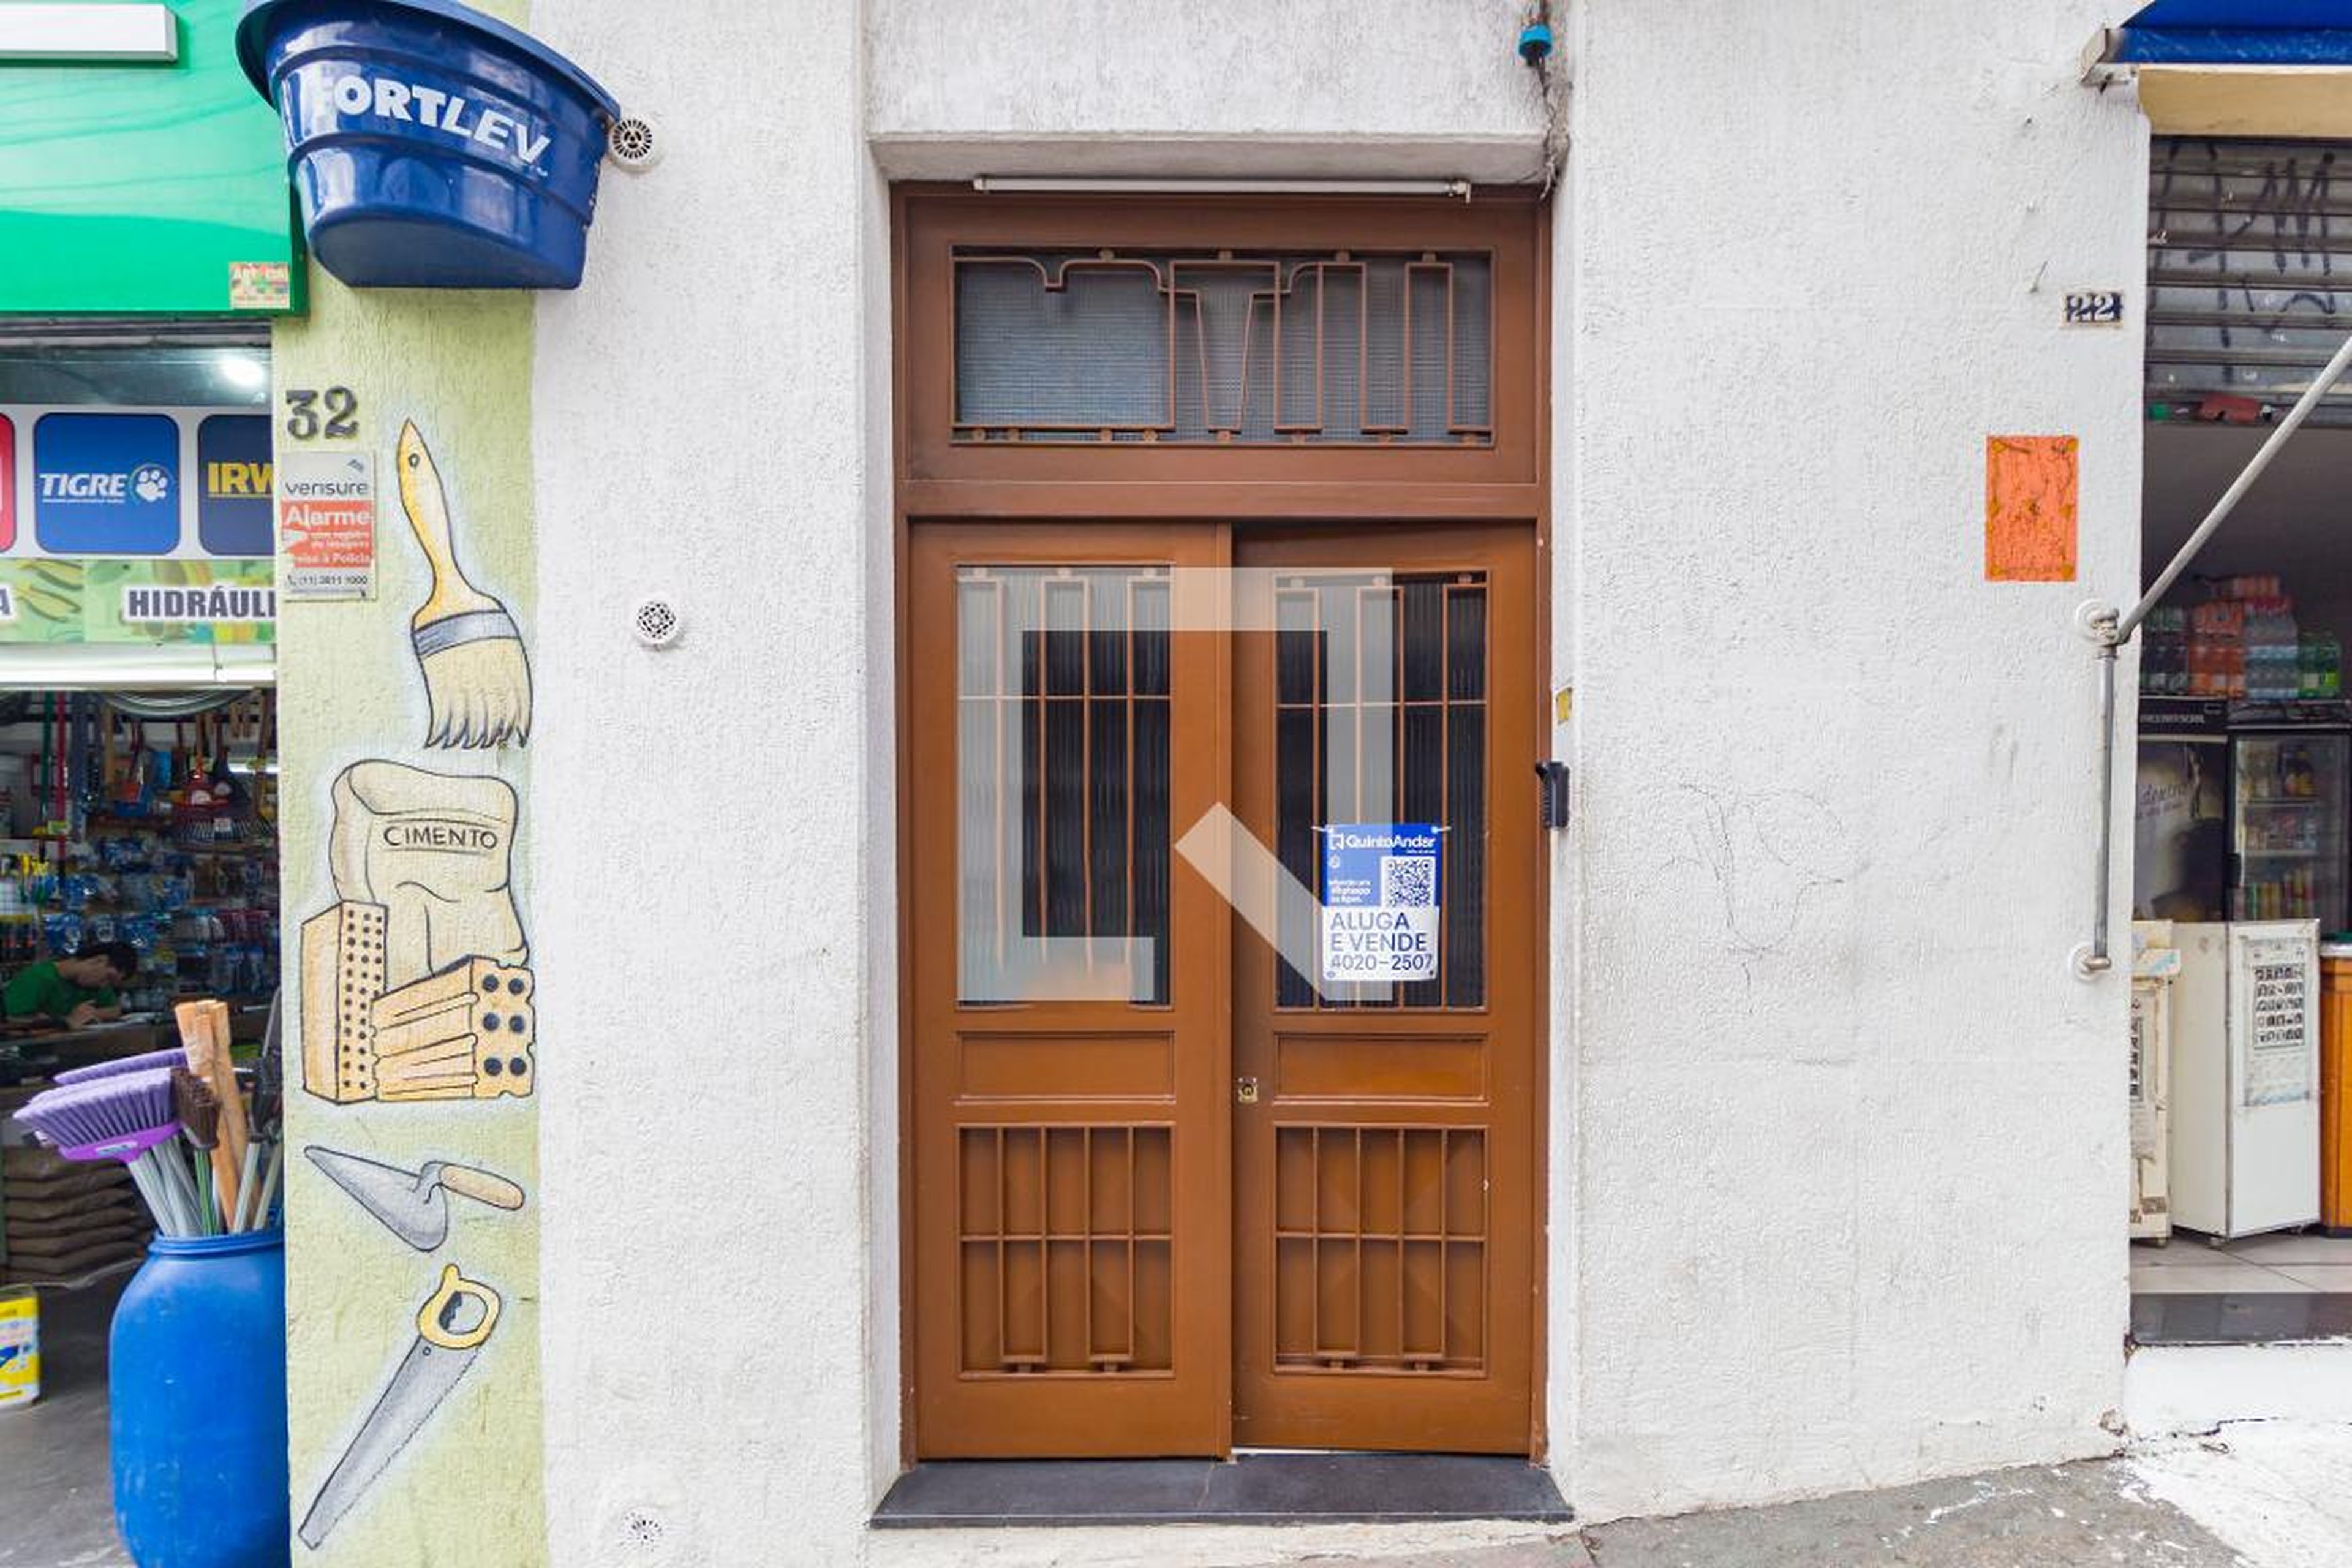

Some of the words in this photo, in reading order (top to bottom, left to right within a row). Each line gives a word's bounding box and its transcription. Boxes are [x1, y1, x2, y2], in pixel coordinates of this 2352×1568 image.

[2069, 293, 2114, 320] 22
[285, 386, 359, 440] 32
[39, 473, 128, 497] TIGRE
[285, 481, 369, 496] verisure
[286, 503, 371, 526] Alarme
[384, 826, 497, 849] CIMENTO
[1331, 913, 1409, 930] ALUGA
[1332, 933, 1343, 951] E
[1349, 933, 1427, 951] VENDE
[1331, 954, 1433, 970] 4020-2507
